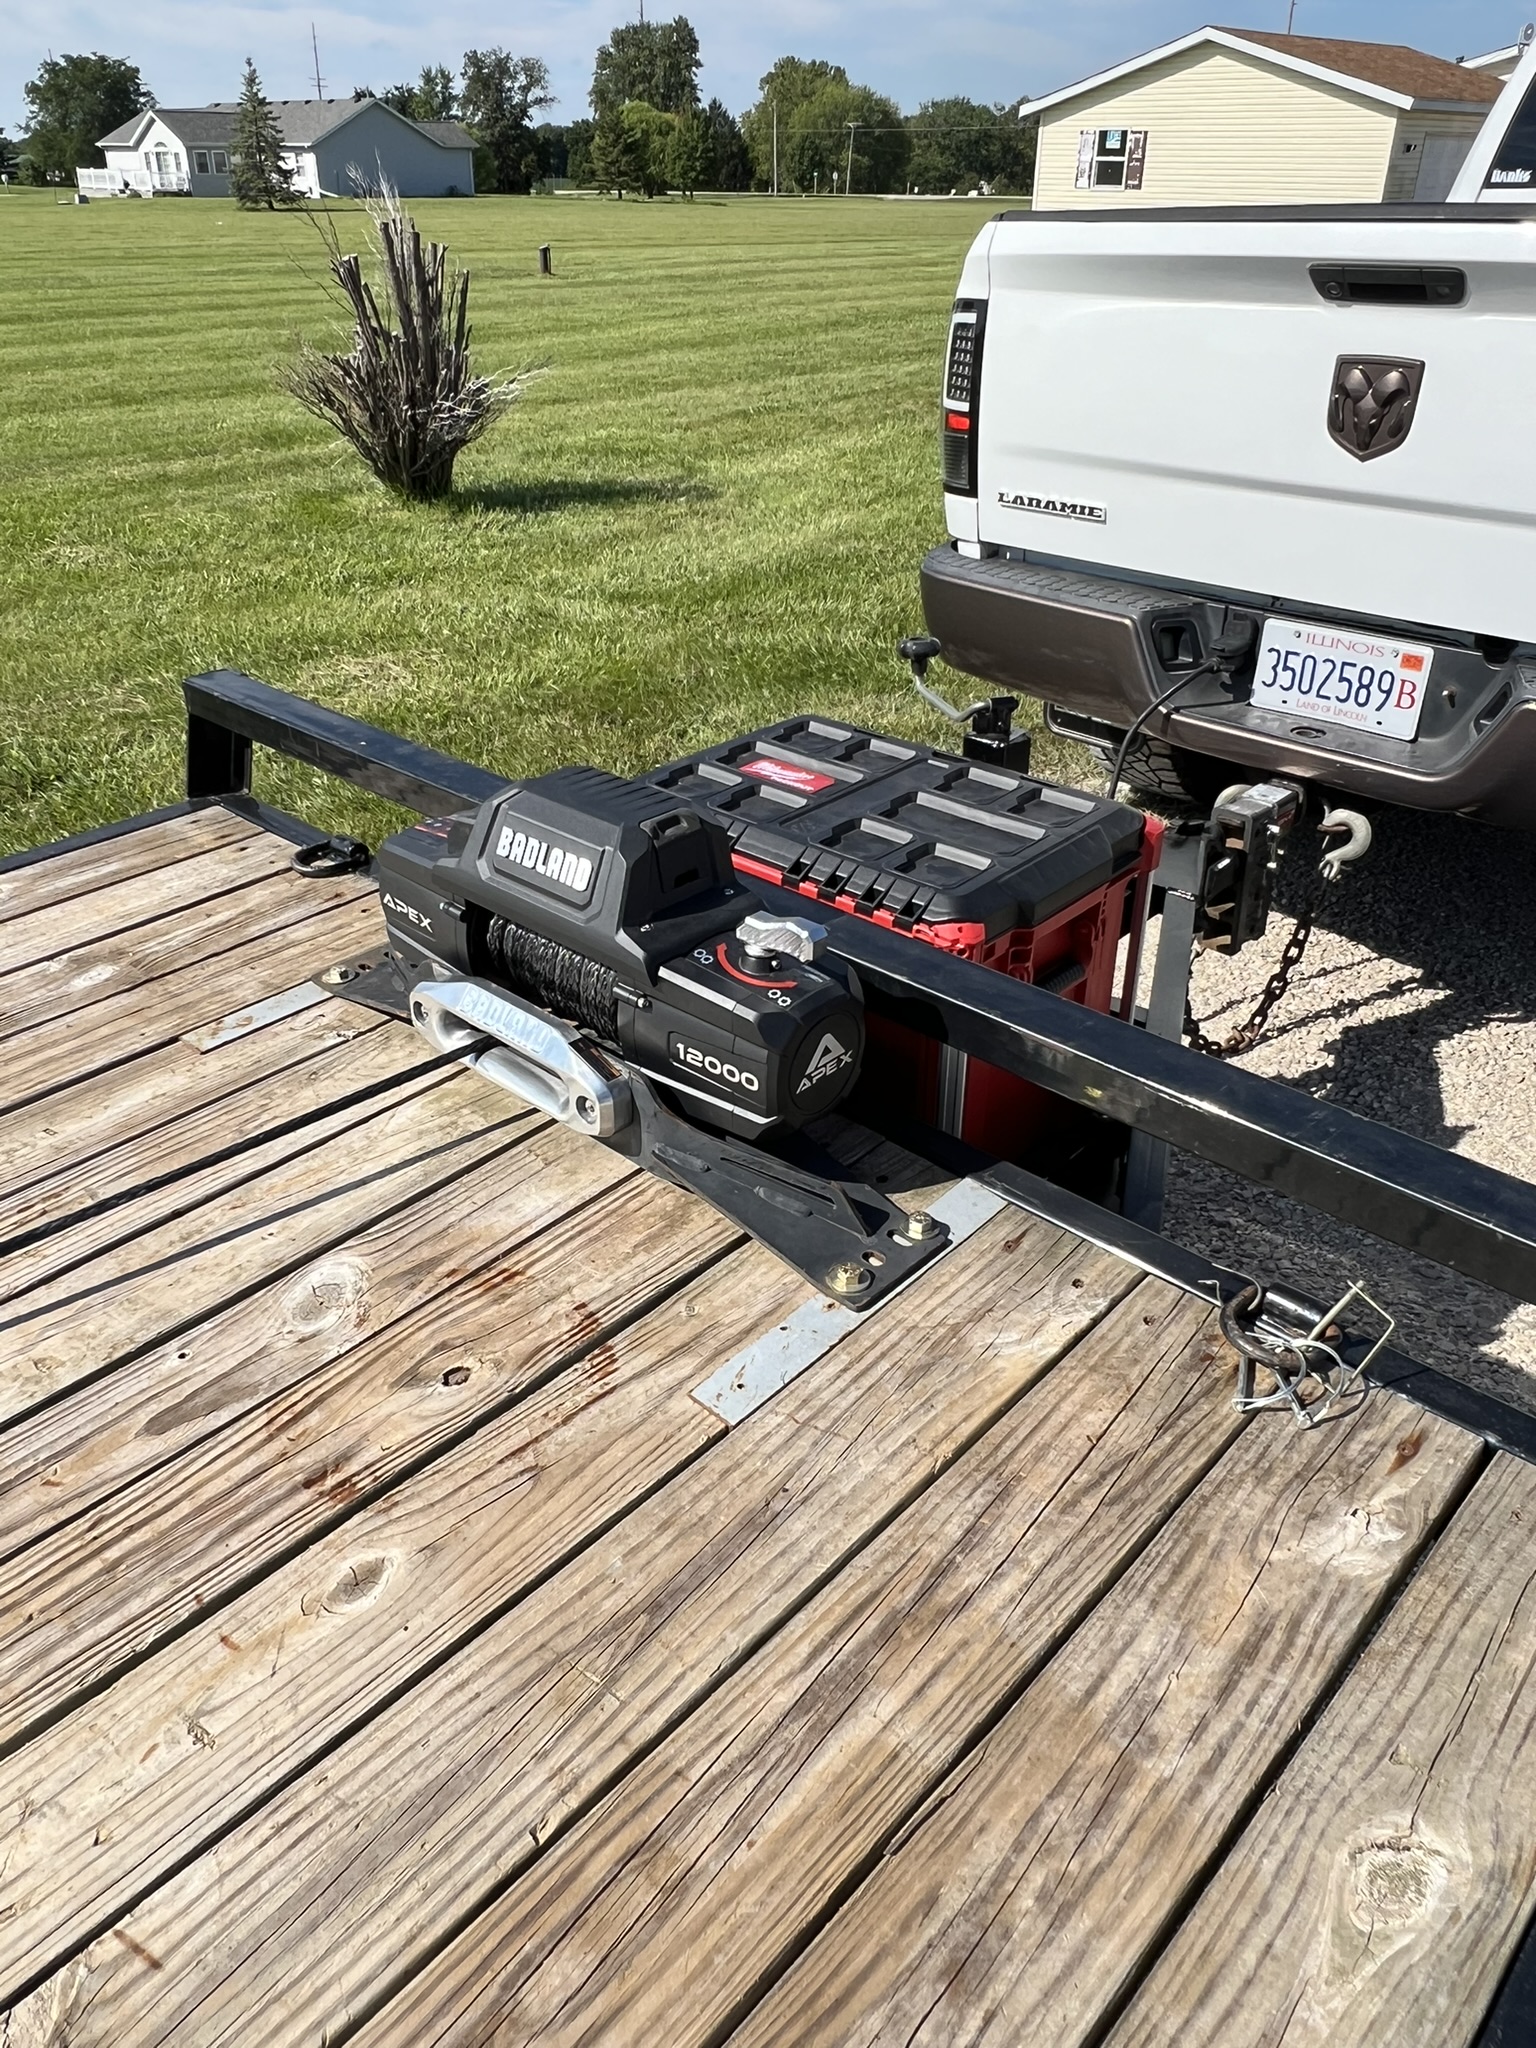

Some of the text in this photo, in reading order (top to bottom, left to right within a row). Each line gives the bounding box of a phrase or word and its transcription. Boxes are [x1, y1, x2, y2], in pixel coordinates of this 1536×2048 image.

[997, 492, 1103, 518] LARAMIE
[1305, 632, 1386, 658] ILLINOIS
[1262, 647, 1417, 712] 3502589 B
[496, 825, 592, 891] BADLAND
[383, 893, 433, 934] APEX
[457, 985, 553, 1054] BADLAND
[676, 1042, 759, 1091] 12000
[796, 1050, 852, 1095] APEX
